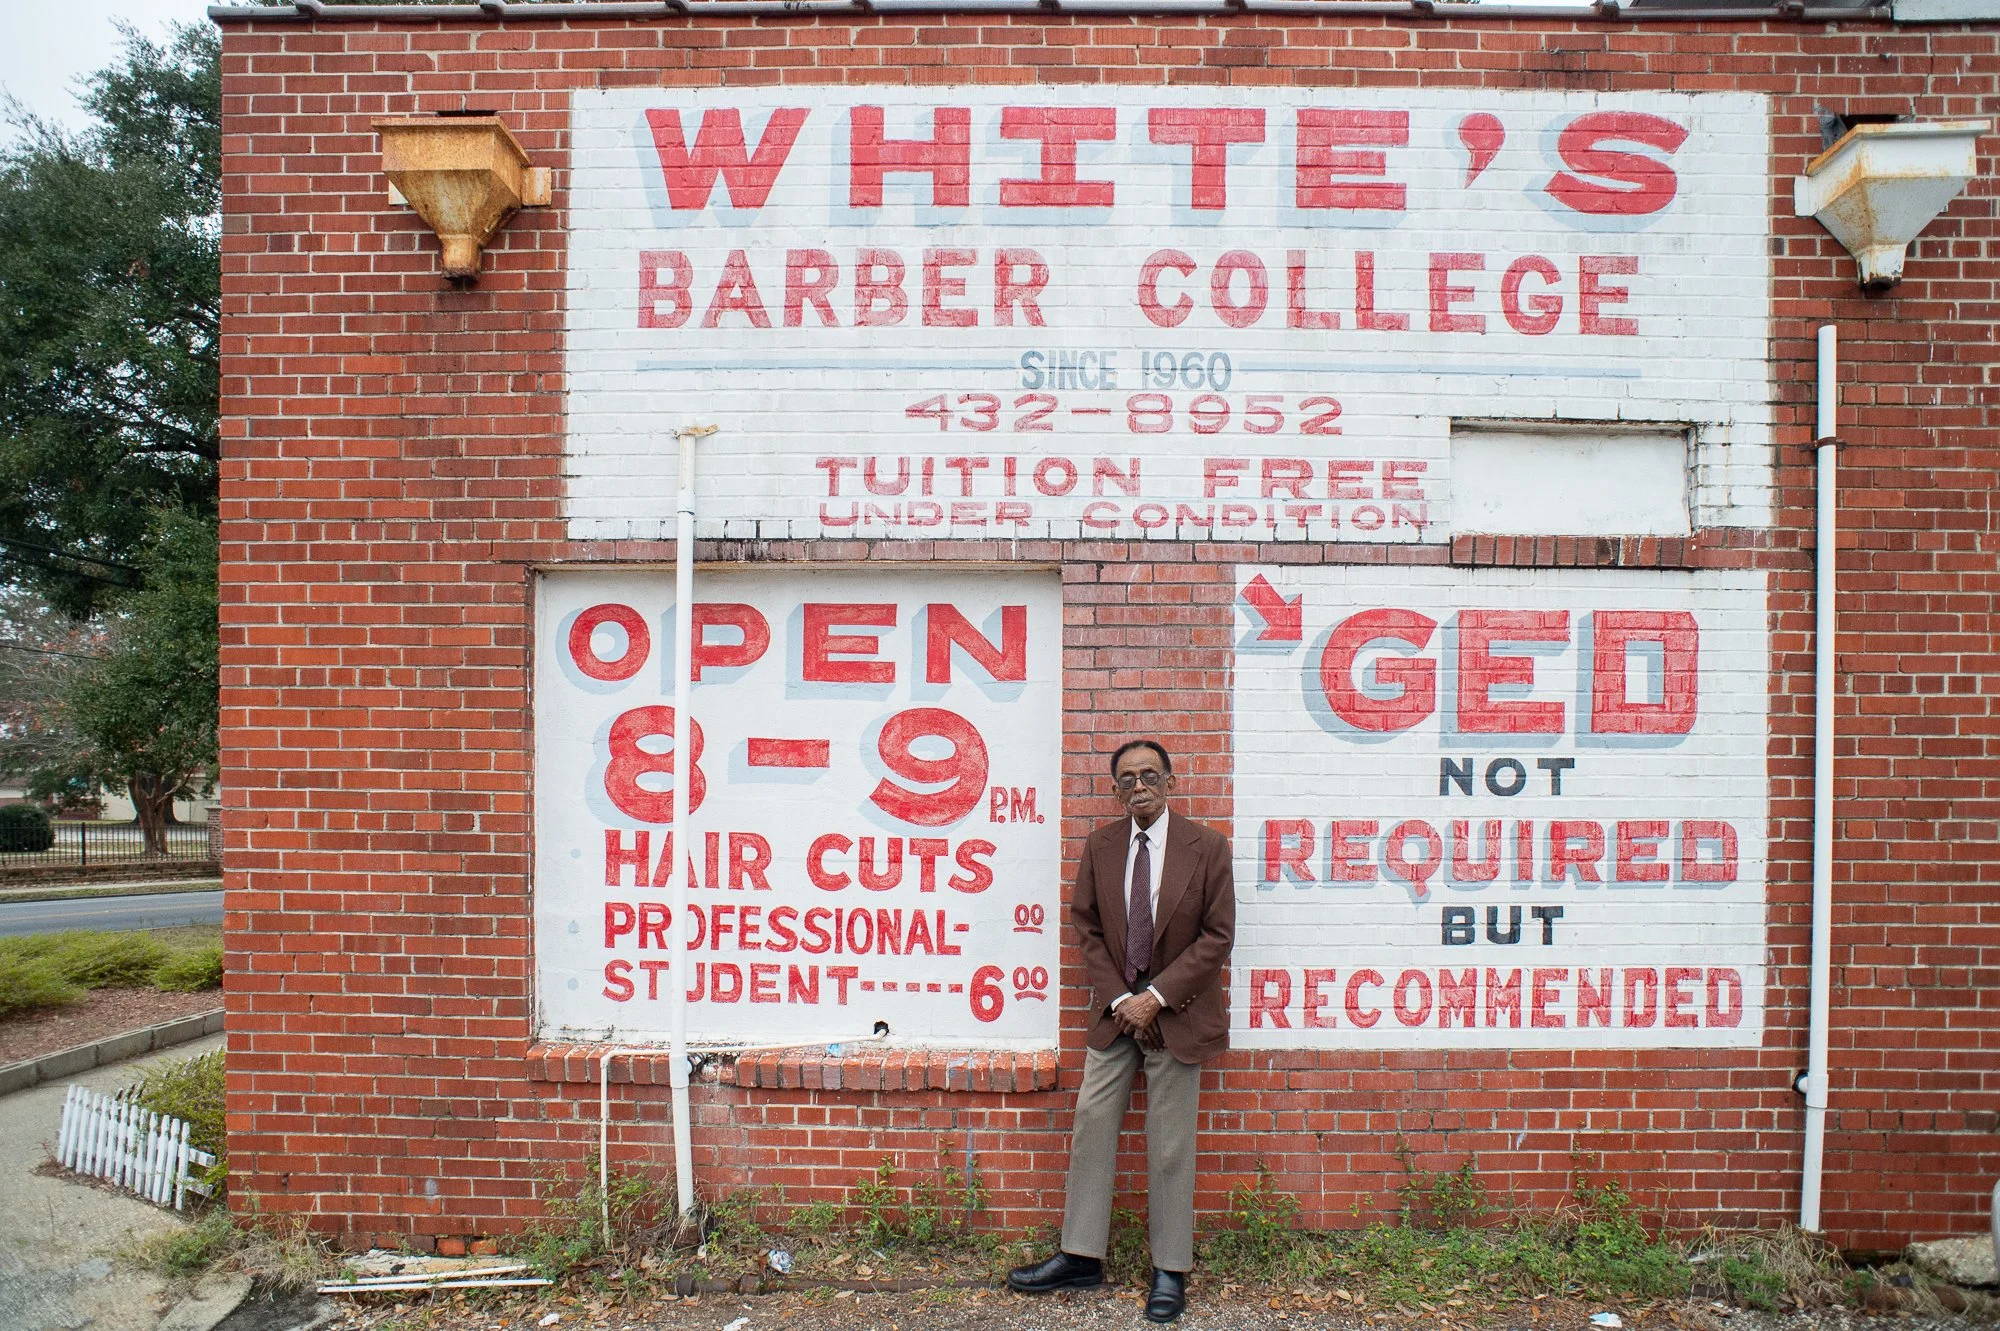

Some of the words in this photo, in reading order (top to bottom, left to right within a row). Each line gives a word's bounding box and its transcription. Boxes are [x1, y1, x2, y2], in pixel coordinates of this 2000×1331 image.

[645, 105, 1687, 215] WHITE'S
[639, 250, 1048, 328] BARBER
[1139, 252, 1637, 336] COLLEGE
[1020, 349, 1116, 388] SINCE
[1144, 352, 1232, 392] 1960
[908, 394, 1341, 435] 432-8952
[817, 457, 1139, 496] TUITION
[1204, 459, 1426, 498] FREE
[820, 503, 1029, 526] UNDER
[1084, 505, 1426, 529] CONDITION
[568, 603, 1027, 684] OPEN
[1321, 608, 1699, 734] GED
[1440, 758, 1574, 796] NOT
[605, 829, 772, 890] HAIR
[806, 833, 996, 894] CUTS
[1265, 820, 1737, 896] REQUIRED
[1441, 906, 1563, 945] BUT
[1249, 967, 1742, 1028] RECOMMENDED
